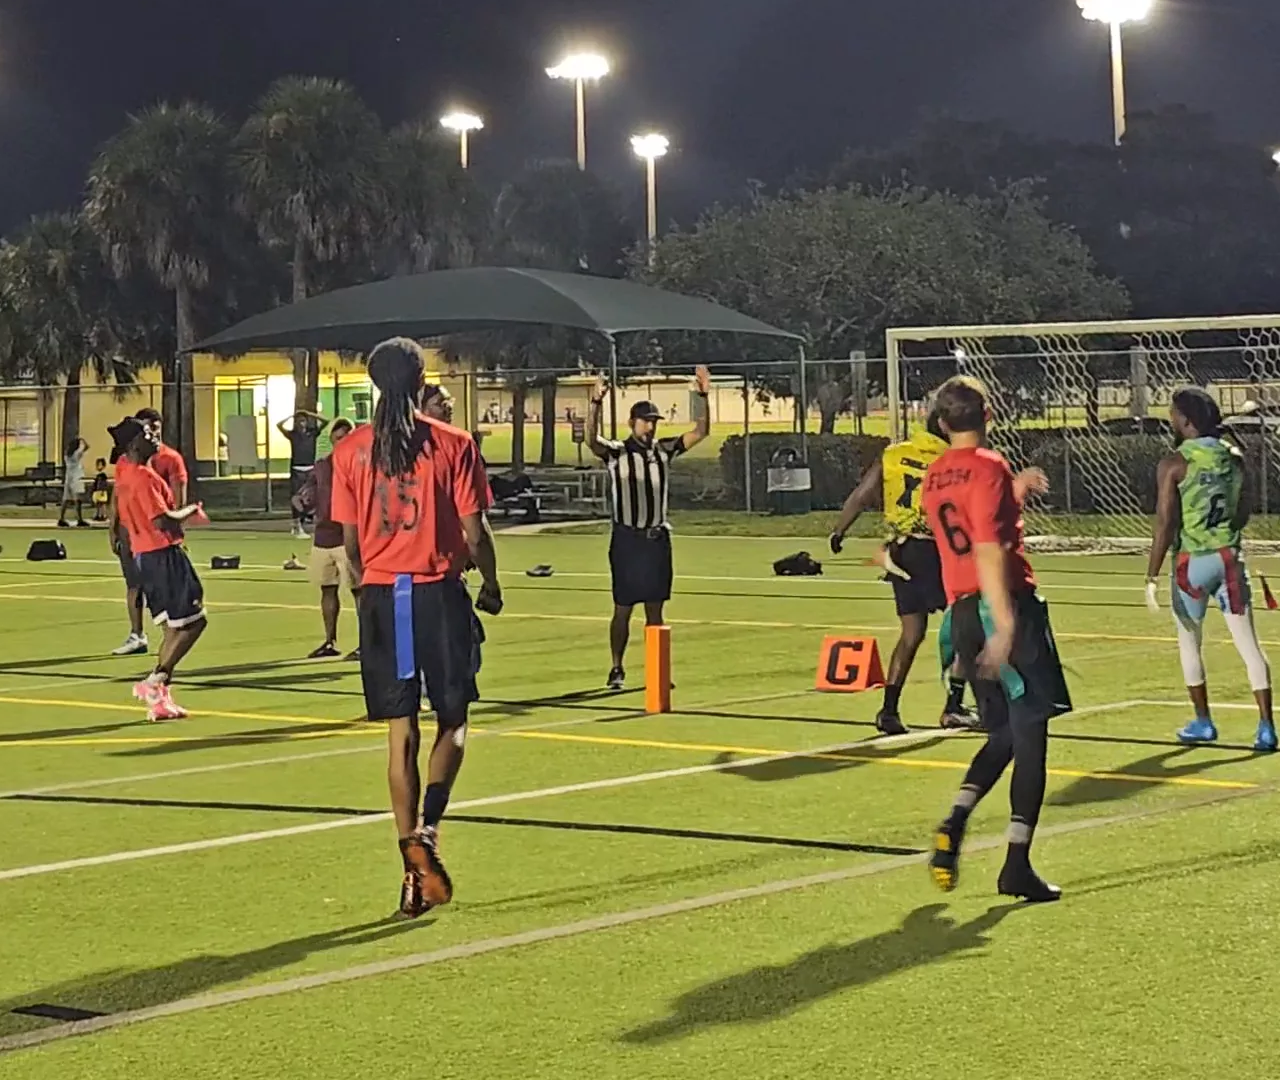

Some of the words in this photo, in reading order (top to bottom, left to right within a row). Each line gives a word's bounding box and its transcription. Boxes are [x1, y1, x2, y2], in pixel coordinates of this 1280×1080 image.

[375, 476, 419, 536] 15
[938, 501, 972, 555] 6
[825, 640, 864, 685] G
